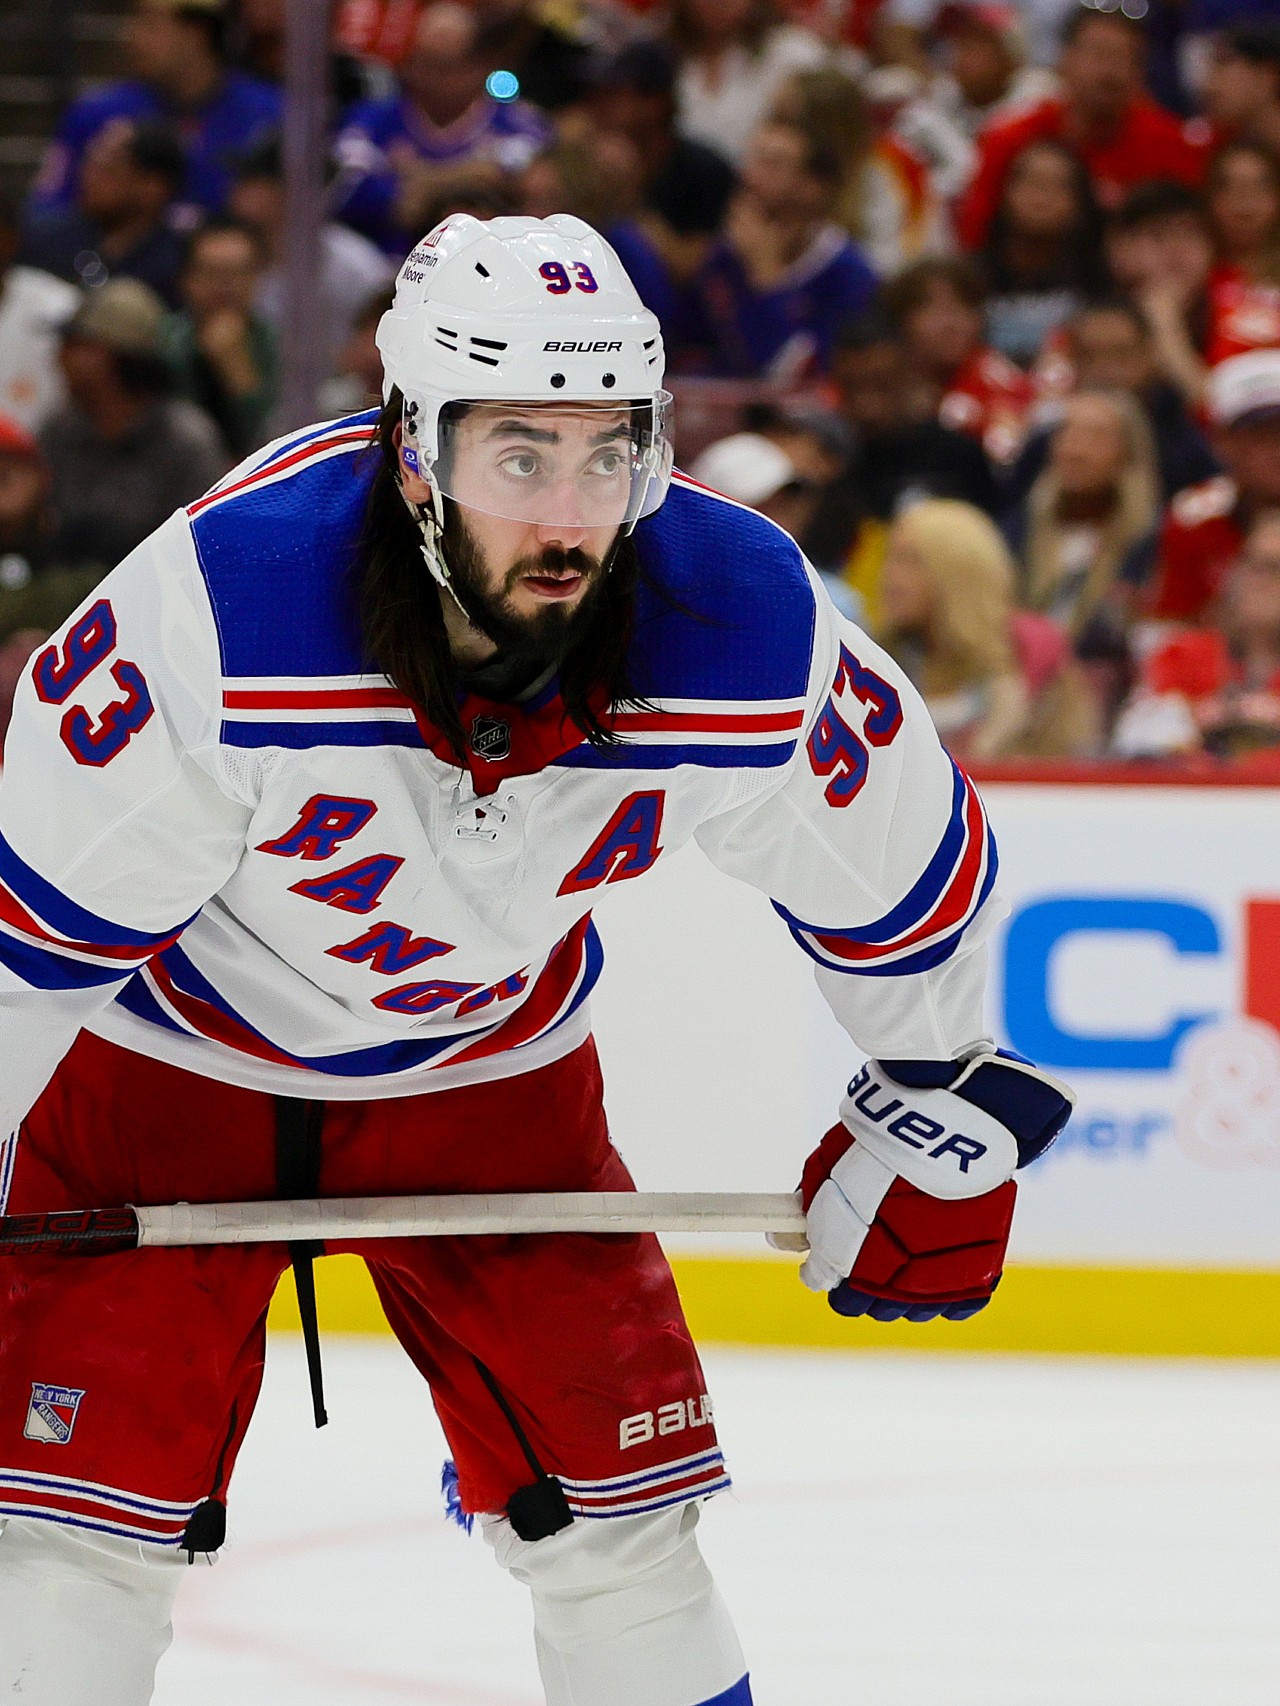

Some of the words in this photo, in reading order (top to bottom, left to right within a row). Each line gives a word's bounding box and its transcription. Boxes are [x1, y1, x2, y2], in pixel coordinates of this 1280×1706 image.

[538, 261, 599, 295] 93
[32, 598, 155, 768] 93
[806, 639, 904, 808] 93
[556, 789, 666, 898] A
[847, 1061, 987, 1174] AUER
[34, 1388, 54, 1401] NEW
[54, 1392, 78, 1405] YORK
[37, 1403, 68, 1439] RANGERS
